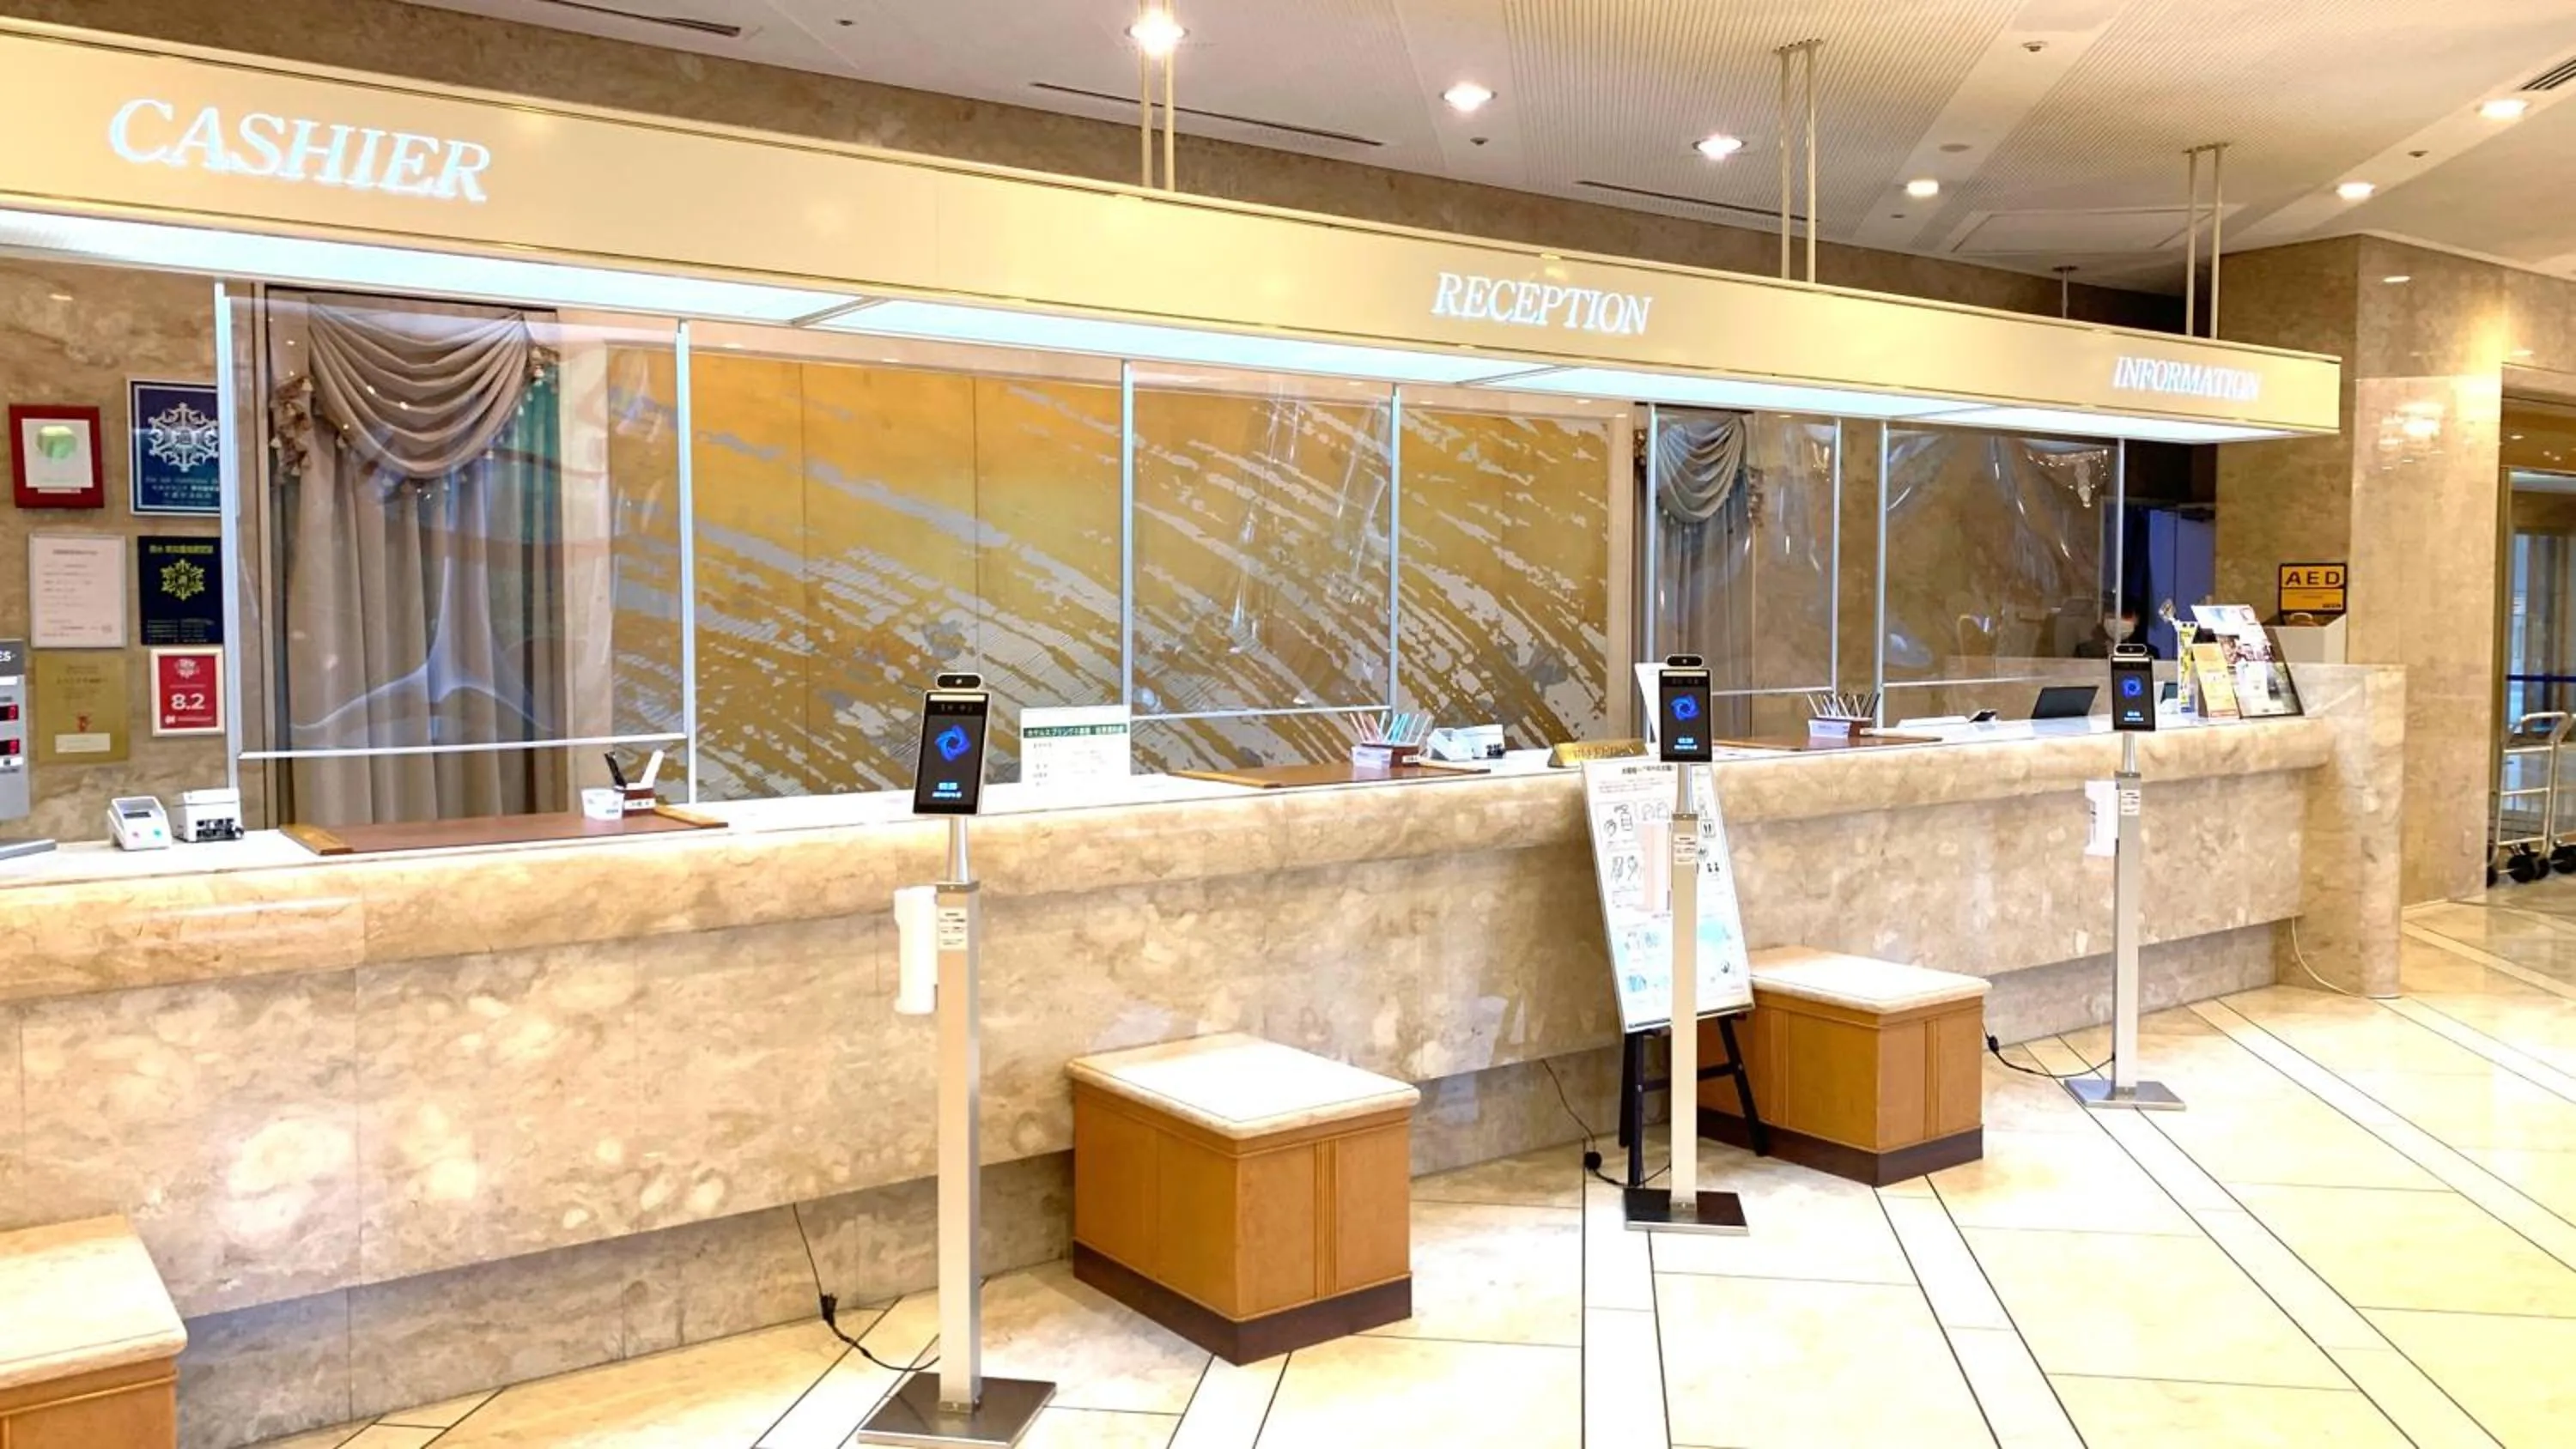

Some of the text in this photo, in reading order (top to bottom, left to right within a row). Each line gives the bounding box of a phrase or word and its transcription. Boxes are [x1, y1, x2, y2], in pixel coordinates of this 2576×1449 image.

[108, 98, 491, 203] CASHIER
[1431, 271, 1653, 335] RECEPTION
[2113, 356, 2262, 400] INFORMATION
[2285, 571, 2340, 585] AED
[171, 693, 205, 710] 8.2
